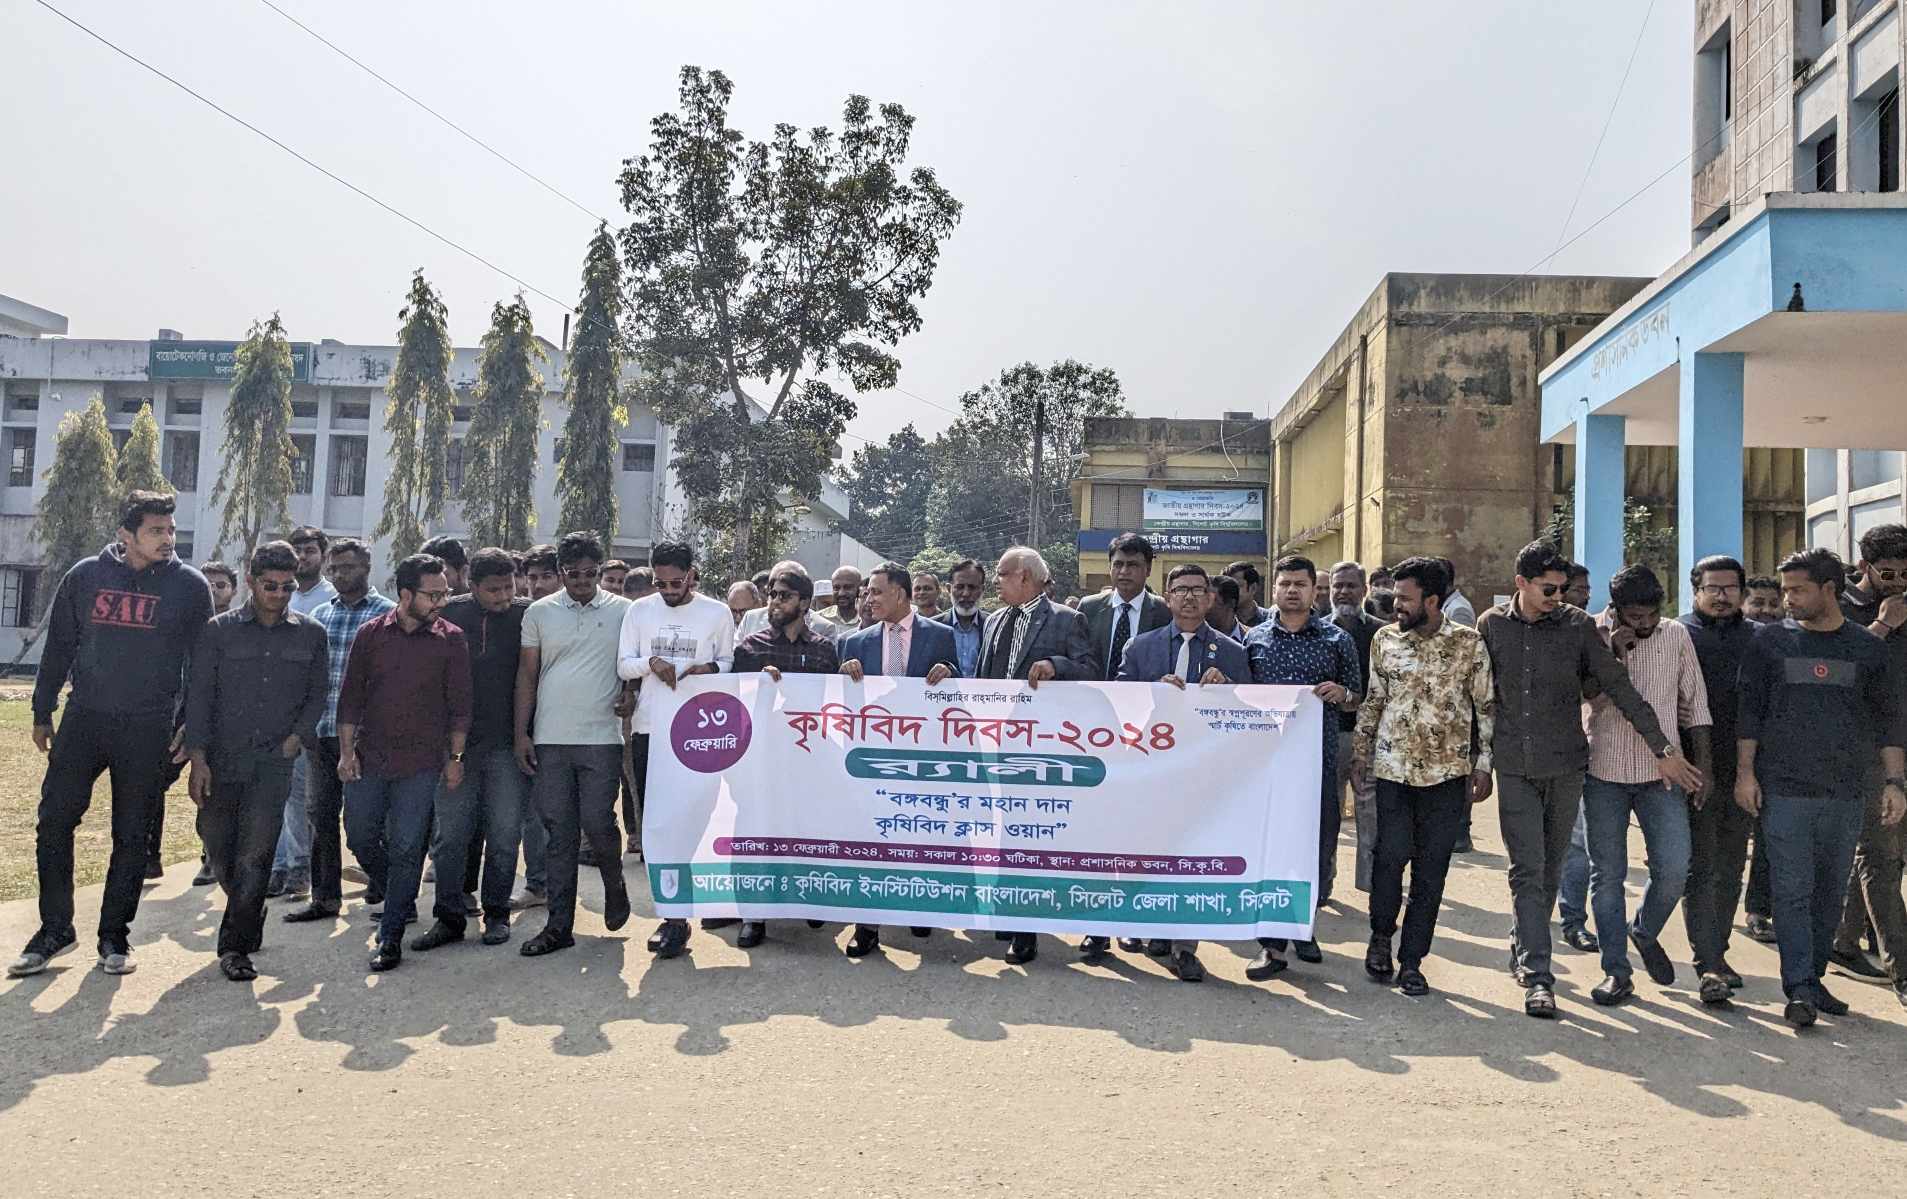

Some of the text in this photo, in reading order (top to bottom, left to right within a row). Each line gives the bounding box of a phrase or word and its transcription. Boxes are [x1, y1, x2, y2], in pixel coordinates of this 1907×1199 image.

[1170, 533, 1209, 546] গ্রন্থাগার
[92, 591, 157, 624] SAU
[697, 708, 728, 728] ১৩
[784, 703, 1176, 756] কৃষিবিদ দিবস-২০২৪
[684, 733, 738, 752] ফেব্রুয়ারি
[977, 795, 1029, 813] মহান
[1034, 798, 1072, 814] দান
[874, 814, 949, 838] কৃষিবিদ
[954, 820, 996, 836] ক্লাস
[773, 843, 788, 852] ১৩
[924, 850, 957, 861] সকাল
[1080, 857, 1137, 870] প্রশাসনিক
[691, 872, 776, 892] আয়োজনে
[793, 871, 853, 900] কৃষিবিদ
[858, 873, 969, 902] ইনস্টিটিউশন
[973, 884, 1062, 911] বাংলাদেশ,
[1068, 884, 1127, 911] সিলেট
[1132, 891, 1180, 912] জেলা
[1184, 892, 1232, 916] শাখা,
[1238, 887, 1293, 912] সিলেট
